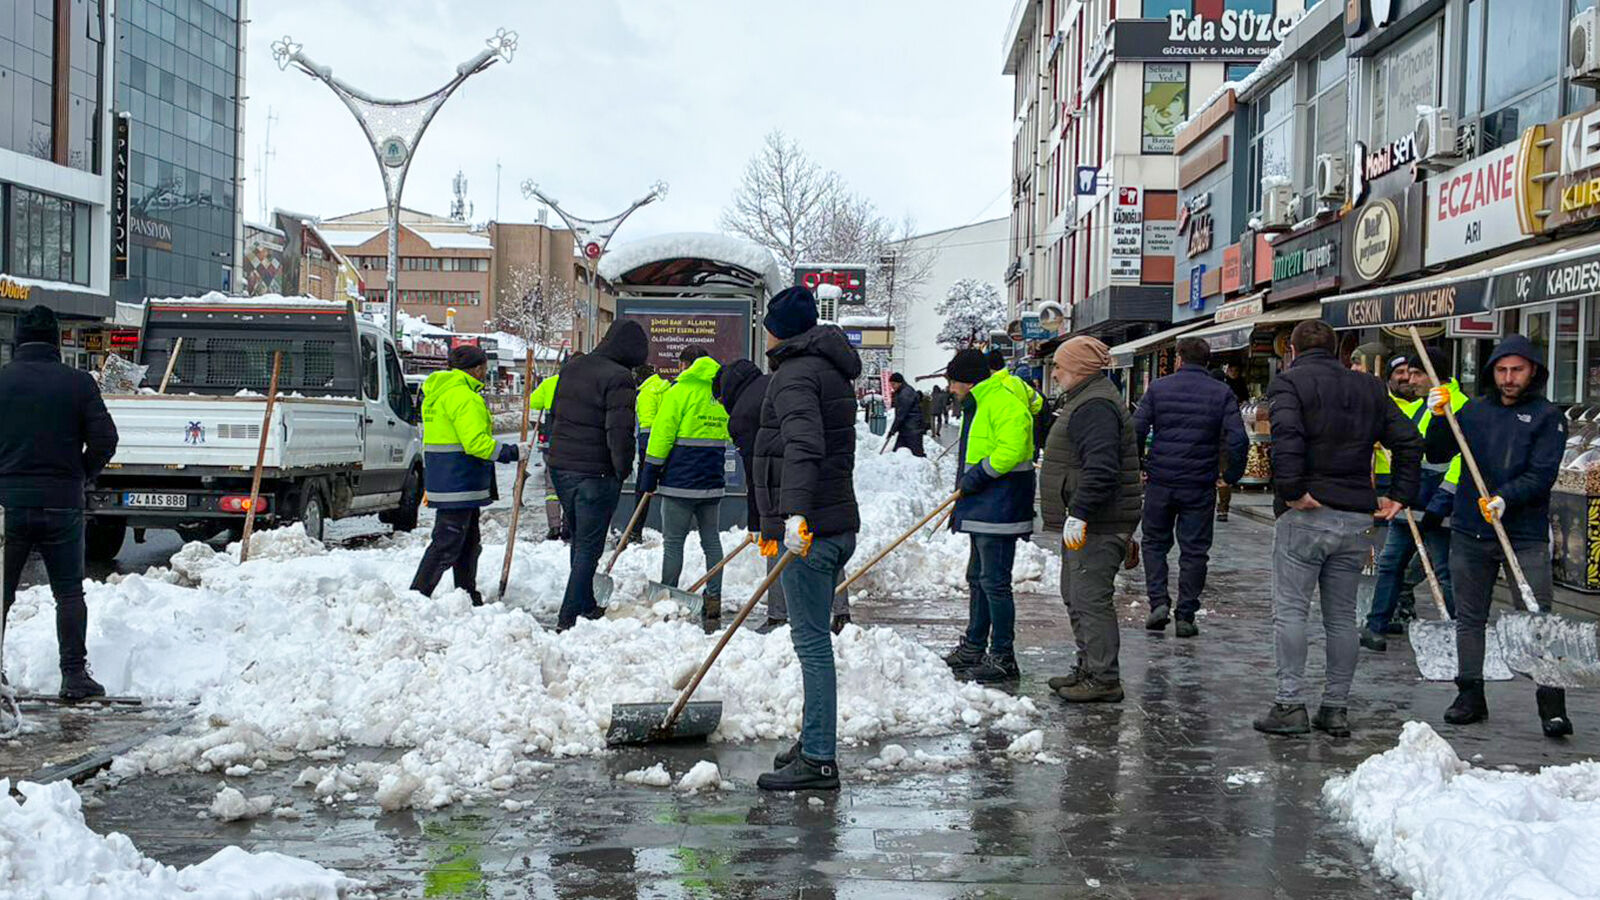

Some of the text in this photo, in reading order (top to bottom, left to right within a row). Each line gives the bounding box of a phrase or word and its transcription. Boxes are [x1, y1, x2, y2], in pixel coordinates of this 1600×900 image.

[1168, 9, 1215, 42] Eda
[1162, 46, 1207, 55] GÜZELLİK
[1247, 46, 1275, 55] DESİ
[1366, 144, 1391, 181] Mobil
[1438, 154, 1515, 222] ECZANE
[1464, 220, 1482, 246] ARI
[1516, 260, 1600, 302] ÜÇ KARDEŞ
[130, 495, 185, 505] 24 AAS 888
